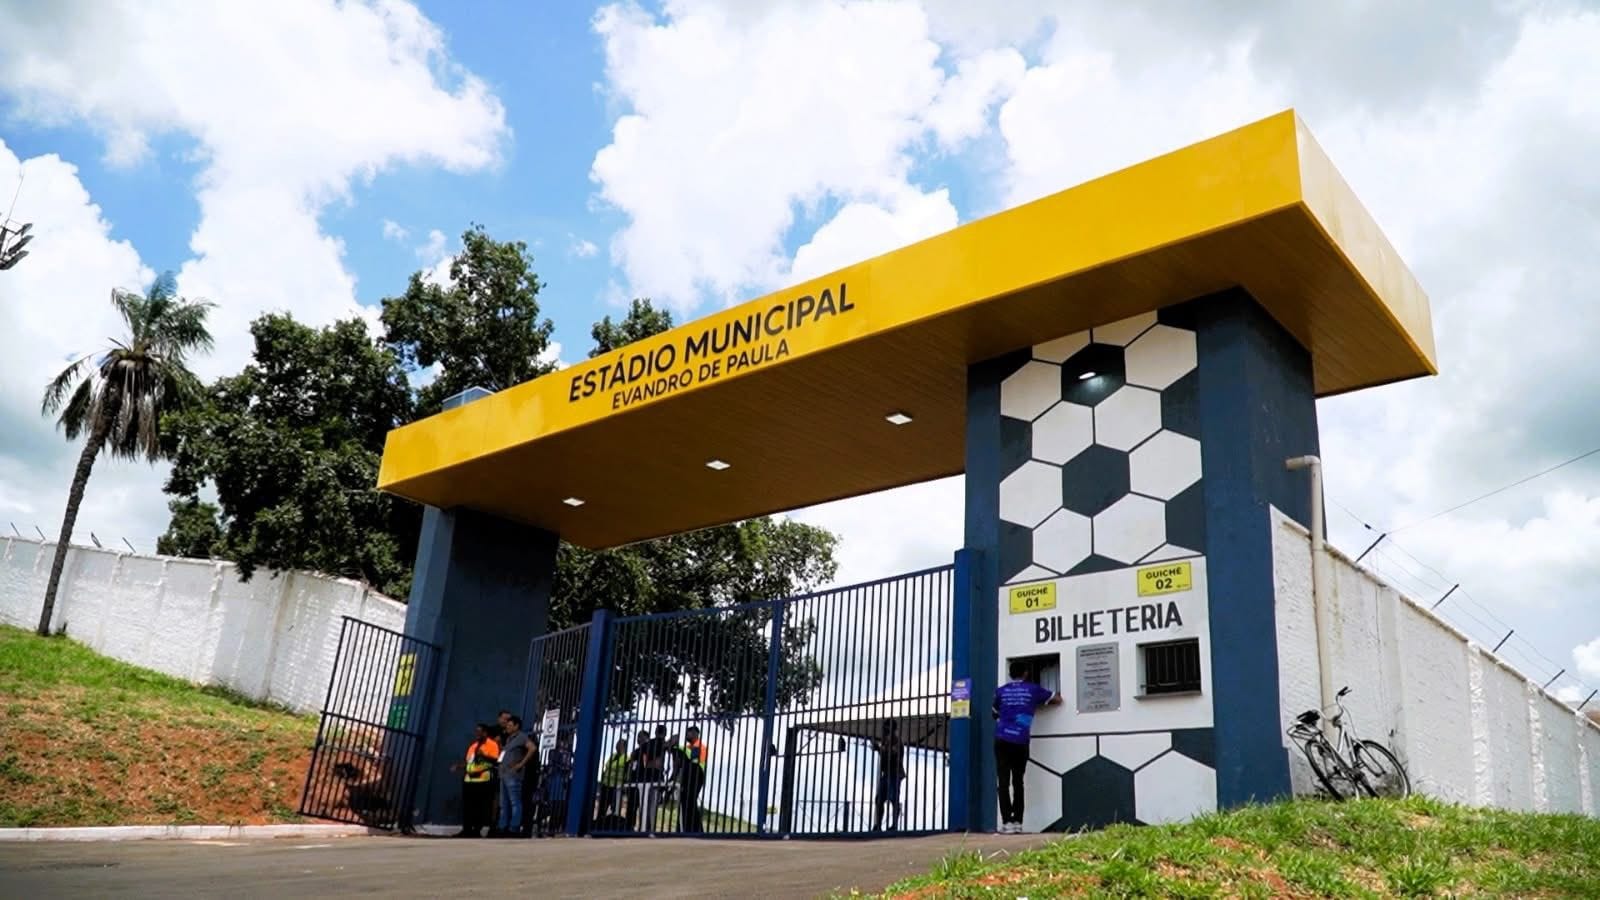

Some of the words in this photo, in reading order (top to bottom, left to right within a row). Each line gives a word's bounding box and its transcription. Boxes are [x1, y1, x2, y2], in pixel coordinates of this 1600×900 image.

[569, 344, 676, 403] ESTÁDIO
[684, 283, 855, 364] MUNICIPAL
[611, 369, 693, 410] EVANDRO
[698, 360, 721, 383] DE
[727, 339, 790, 374] PAULA
[1025, 597, 1040, 609] 01
[1155, 578, 1173, 591] 02
[1035, 601, 1183, 644] BILHETERIA
